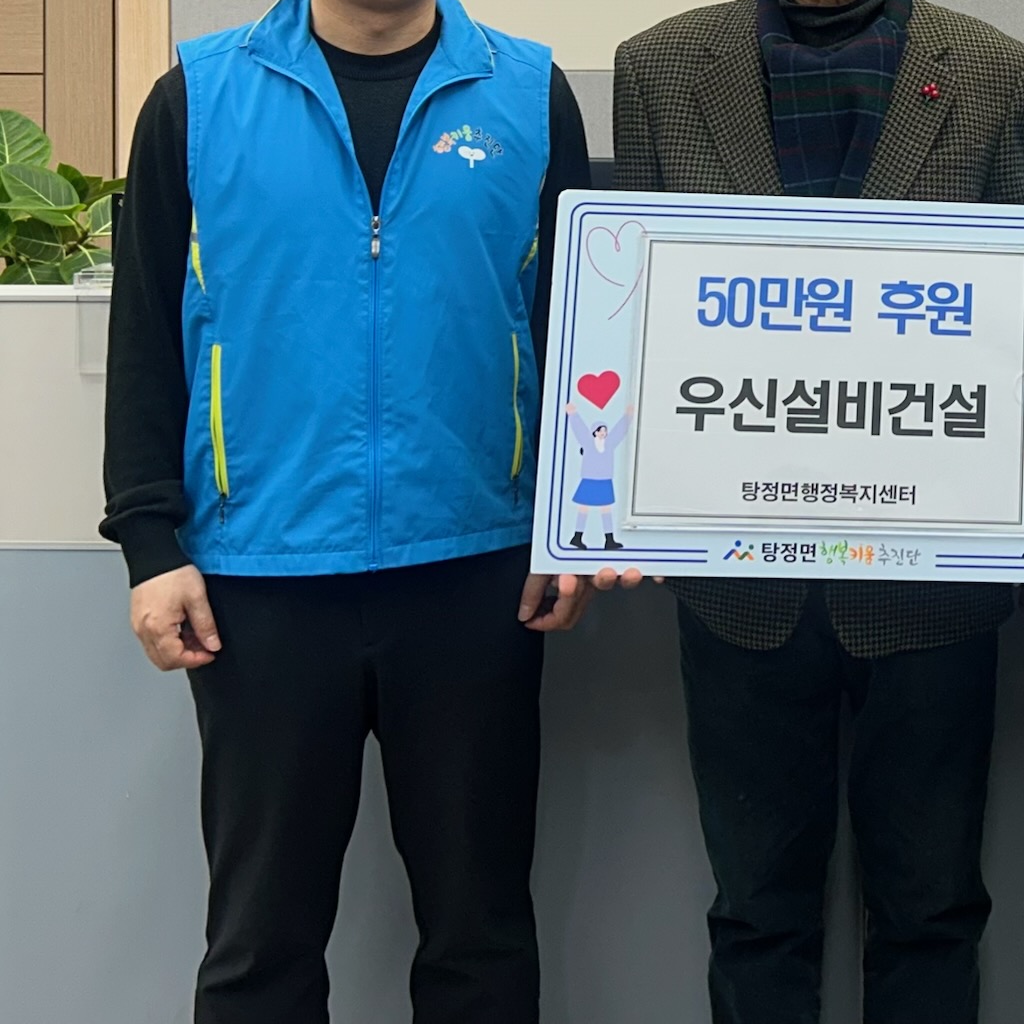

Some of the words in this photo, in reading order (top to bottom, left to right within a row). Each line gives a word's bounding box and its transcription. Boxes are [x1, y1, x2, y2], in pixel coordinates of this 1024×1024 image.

[697, 276, 853, 333] 50만원
[877, 280, 973, 337] 후원
[675, 376, 987, 439] 우신설비건설
[741, 481, 918, 507] 탕정면행정복지센터
[761, 542, 817, 563] 탕정면
